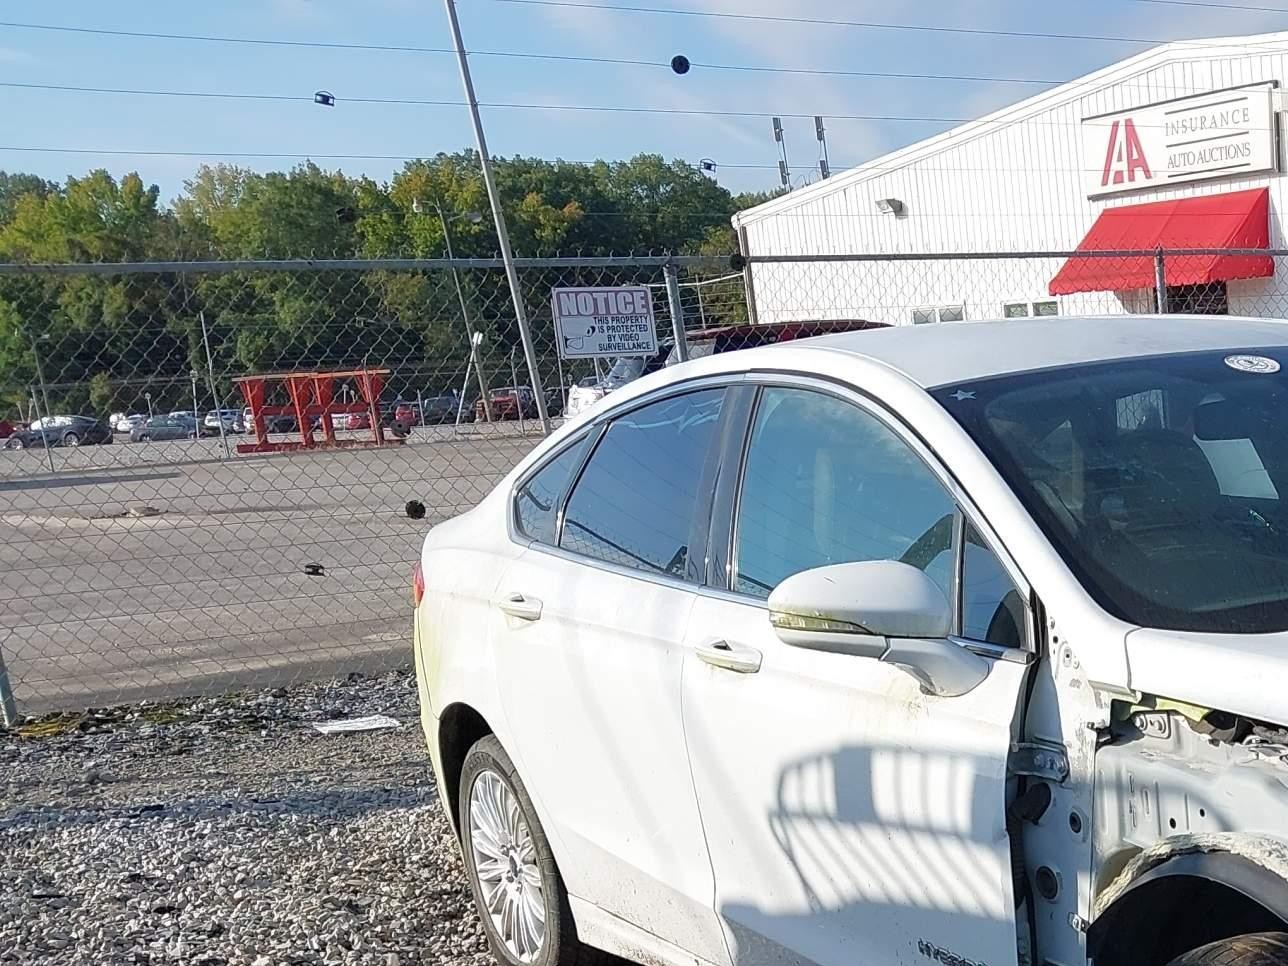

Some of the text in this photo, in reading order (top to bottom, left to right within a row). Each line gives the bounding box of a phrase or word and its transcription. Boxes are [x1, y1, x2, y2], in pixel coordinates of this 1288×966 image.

[1164, 107, 1250, 137] INSURANCE
[1167, 142, 1251, 169] AUTO AUCTIONS
[560, 291, 648, 316] NOTICE
[593, 315, 649, 325] THIS PROPERTY
[597, 324, 649, 334] IS PROTECTED
[607, 333, 640, 342] BY VIDEO
[598, 341, 652, 352] SURVEILLANCE
